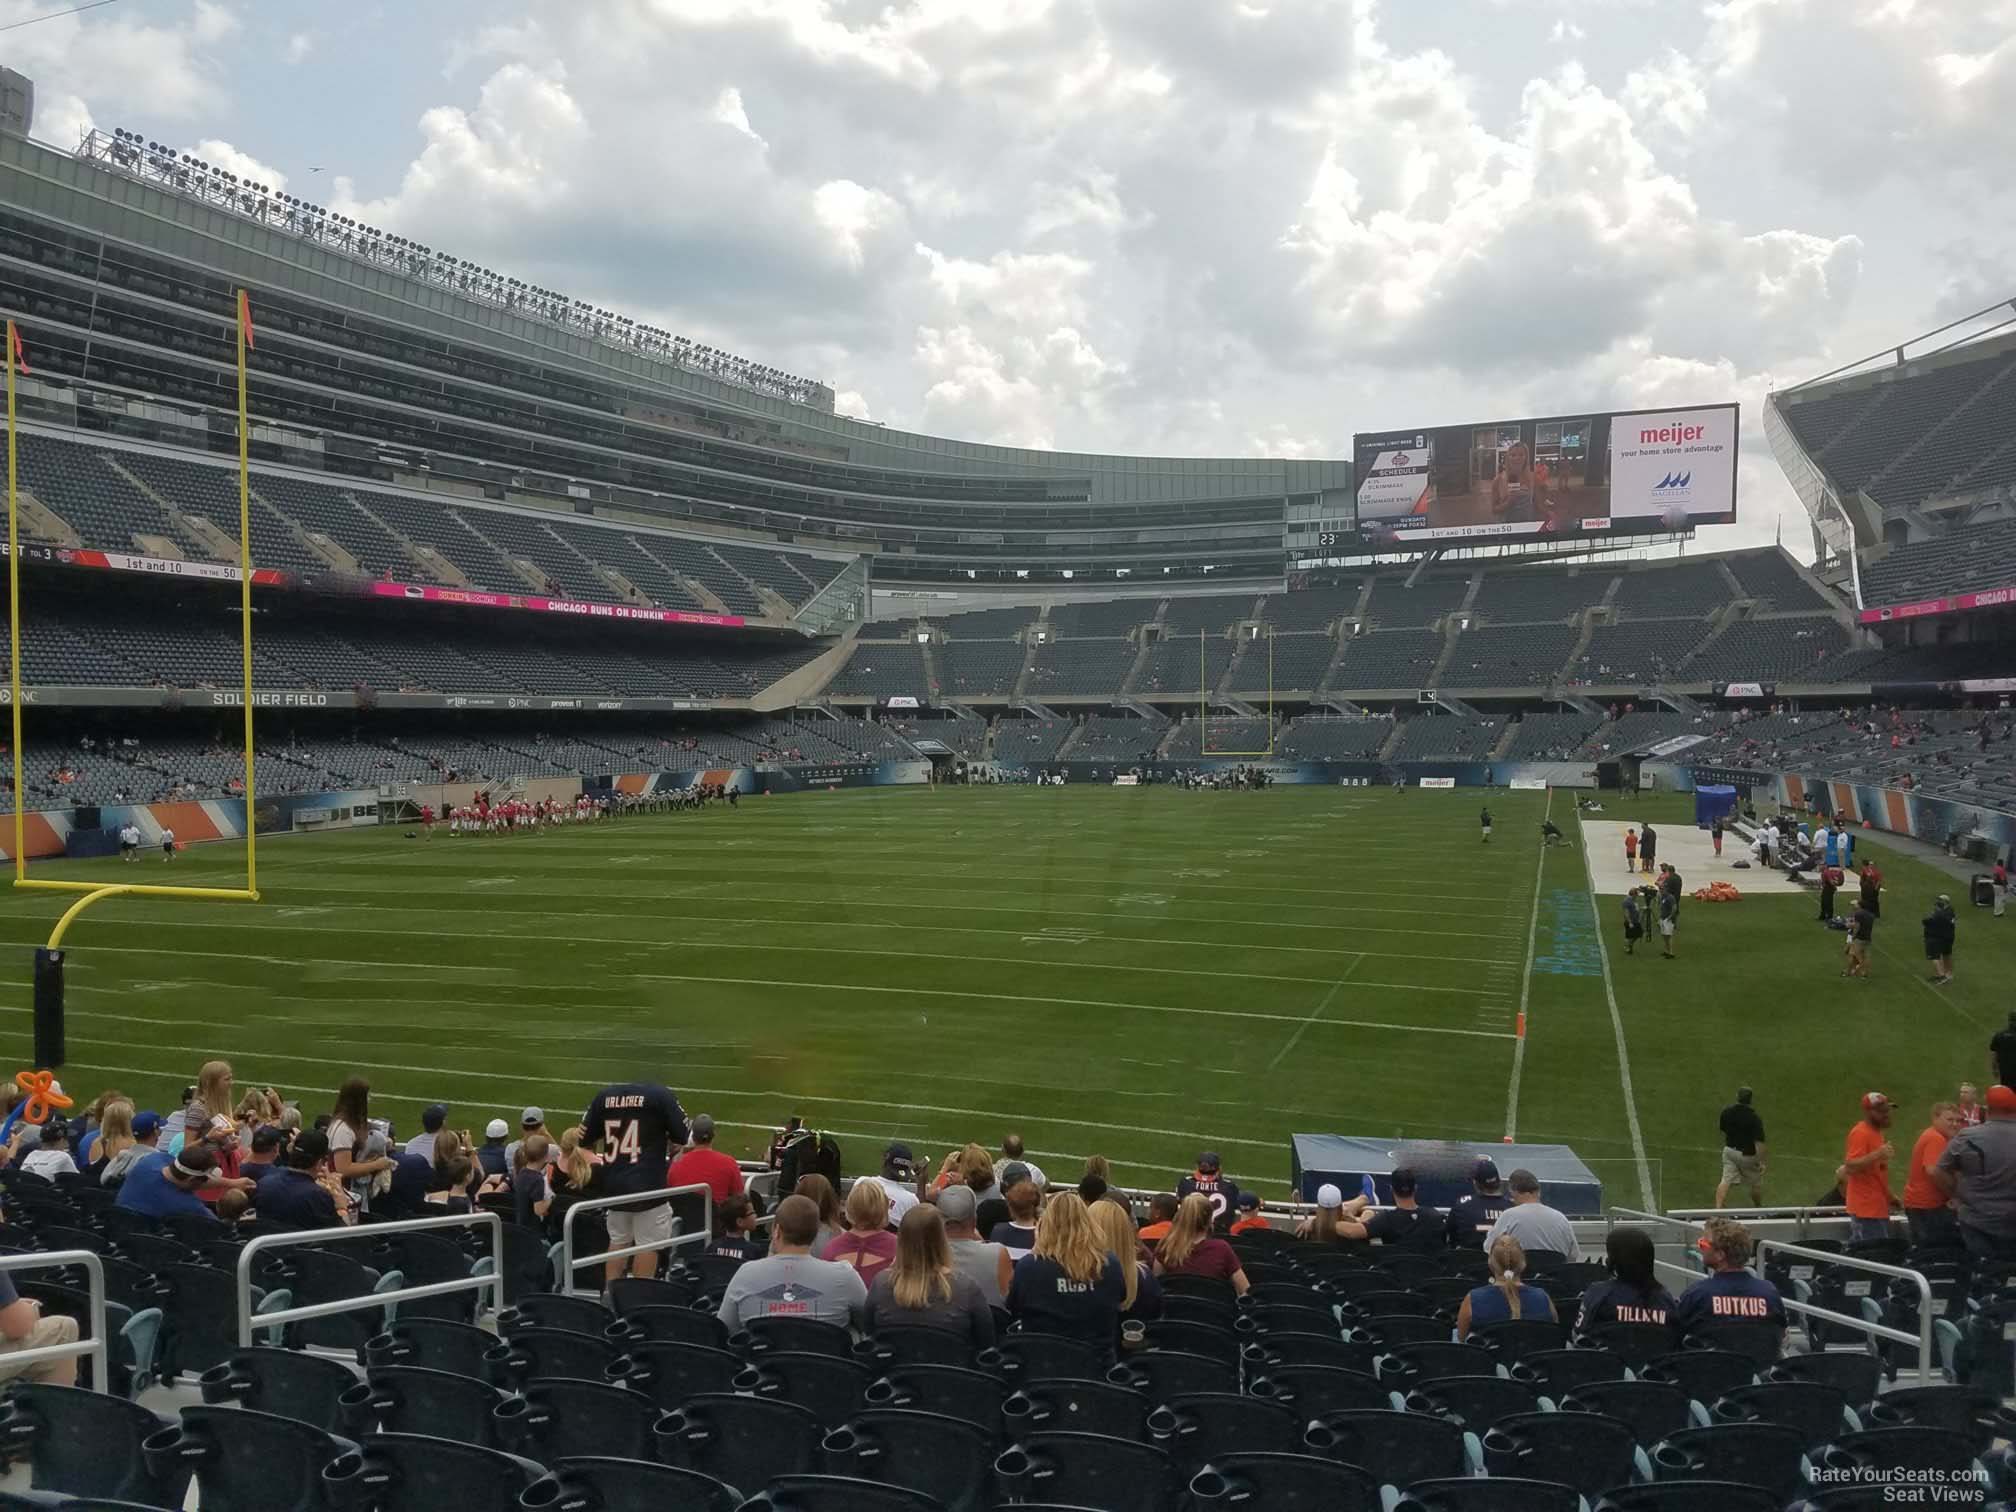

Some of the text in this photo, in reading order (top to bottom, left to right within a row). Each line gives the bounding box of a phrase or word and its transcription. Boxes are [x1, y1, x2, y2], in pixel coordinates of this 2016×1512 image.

[1640, 422, 1705, 446] meijer
[1621, 444, 1723, 458] your home store advantage
[1379, 467, 1417, 476] SCHEDULE
[1462, 527, 1472, 535] 10
[1501, 525, 1512, 533] 50
[1584, 519, 1608, 528] meijer
[1320, 533, 1335, 545] 23
[43, 548, 51, 560] 3
[126, 558, 142, 568] 1st
[147, 561, 165, 571] and
[170, 563, 182, 573] 10
[223, 568, 236, 578] 50
[1976, 590, 2008, 606] CHICAGO
[548, 601, 587, 613] CHICAGO
[591, 605, 613, 616] RUNS
[616, 608, 629, 617] ON
[286, 694, 327, 705] FIELD
[551, 700, 575, 708] proven
[604, 1095, 645, 1109] URLACHER
[604, 1118, 642, 1164] 54
[1195, 1181, 1219, 1191] FORTE
[1712, 1295, 1768, 1317] BUTKUS
[1616, 1305, 1667, 1325] TILLMAN
